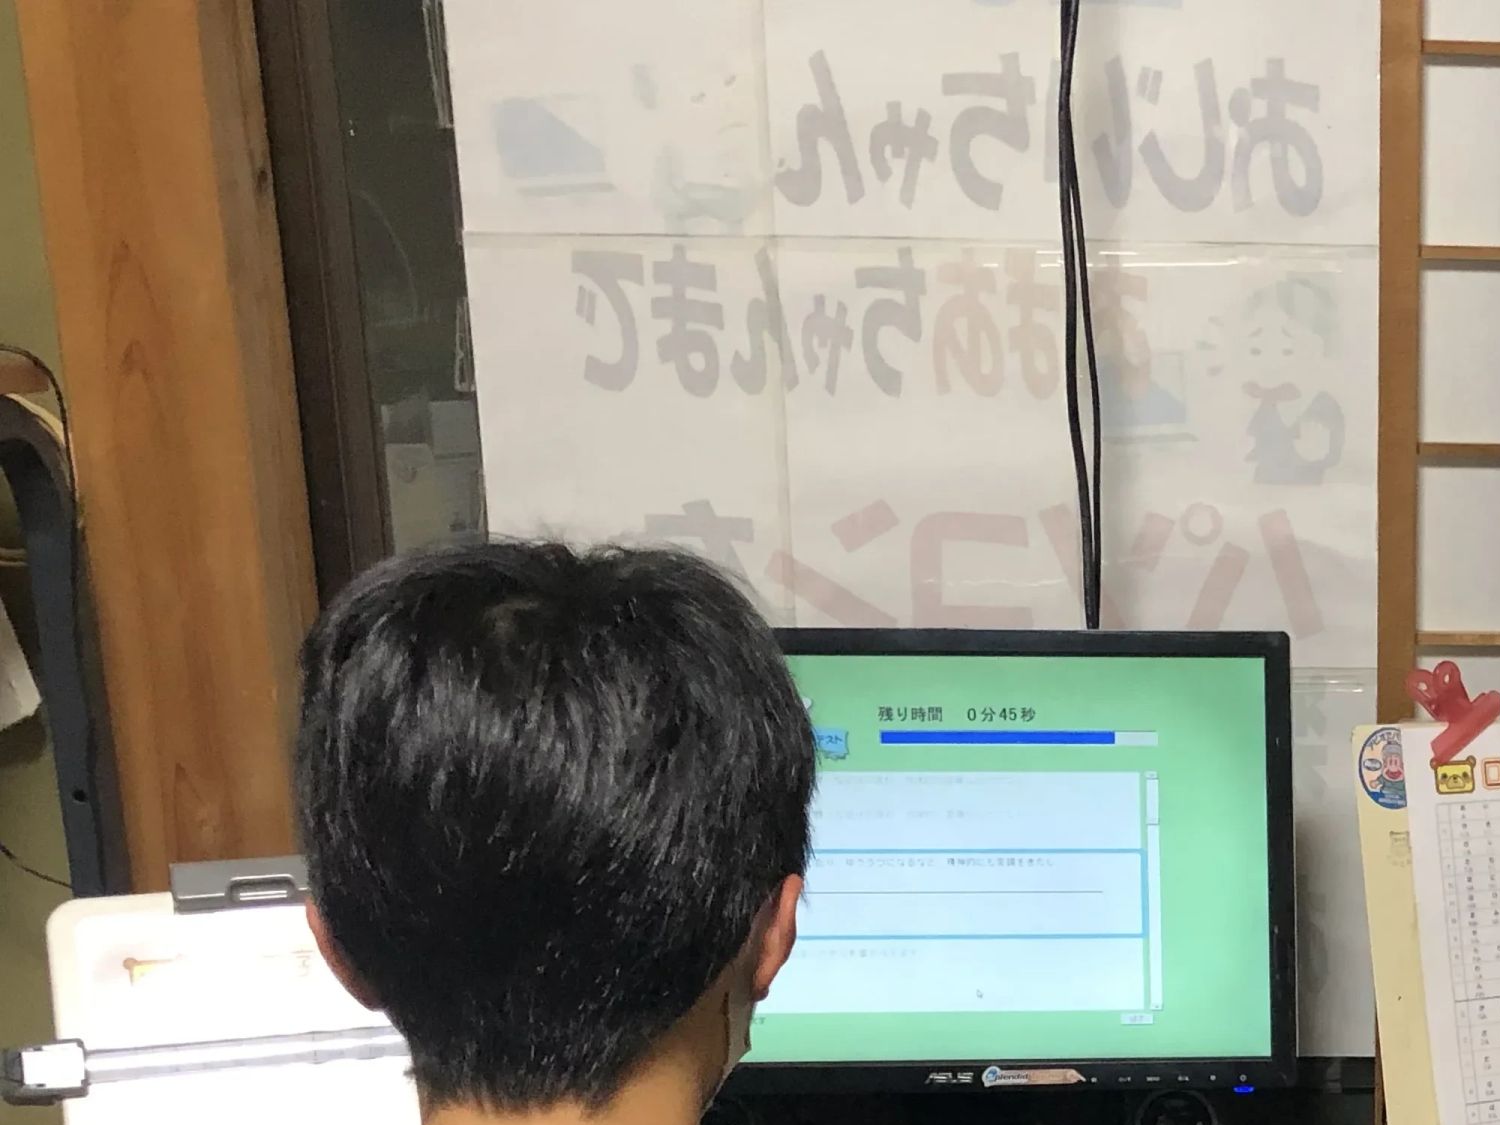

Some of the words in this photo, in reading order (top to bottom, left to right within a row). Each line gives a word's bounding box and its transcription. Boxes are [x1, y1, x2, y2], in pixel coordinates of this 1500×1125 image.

[878, 706, 943, 722] 残り時間
[967, 707, 1036, 722] 0分45秒
